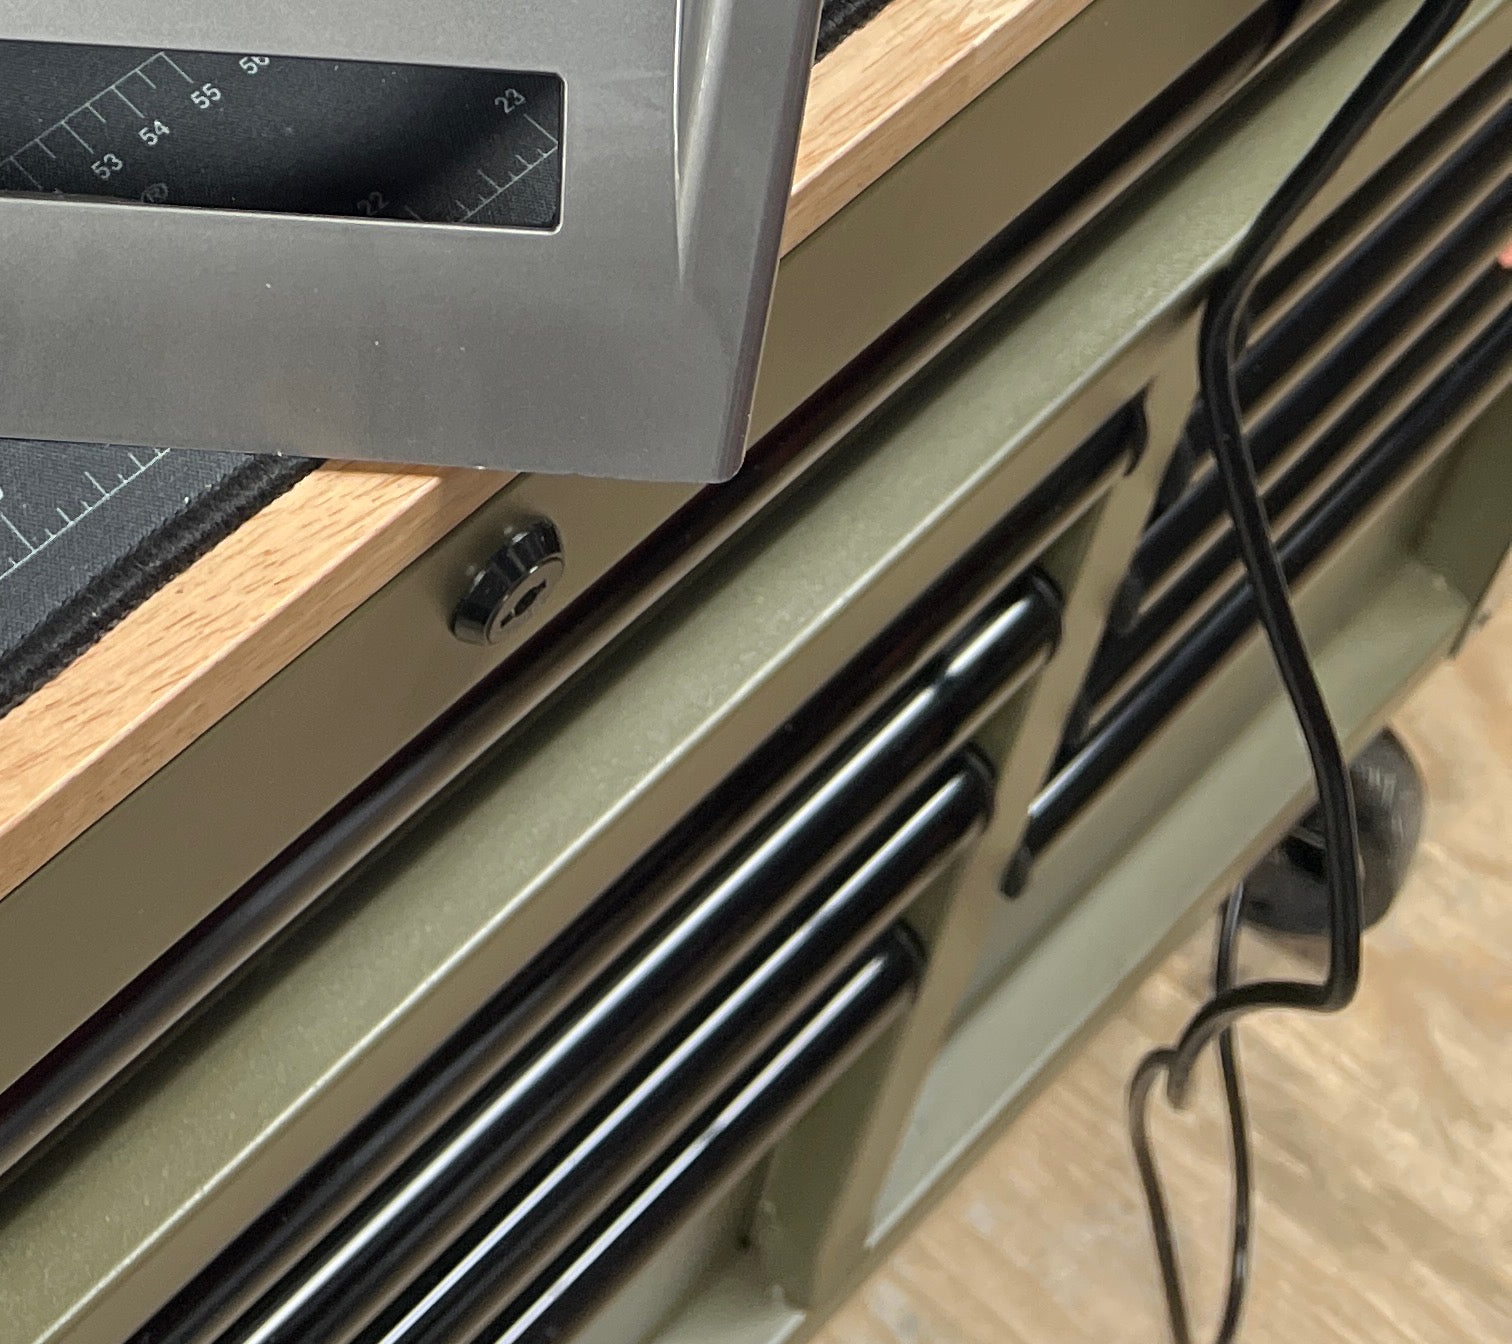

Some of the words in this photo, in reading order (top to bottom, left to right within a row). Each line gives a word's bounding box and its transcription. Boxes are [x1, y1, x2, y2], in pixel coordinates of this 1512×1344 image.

[191, 84, 222, 110] 55
[495, 88, 526, 114] 23
[139, 120, 171, 148] 54
[91, 153, 124, 180] 53
[355, 190, 388, 216] 22
